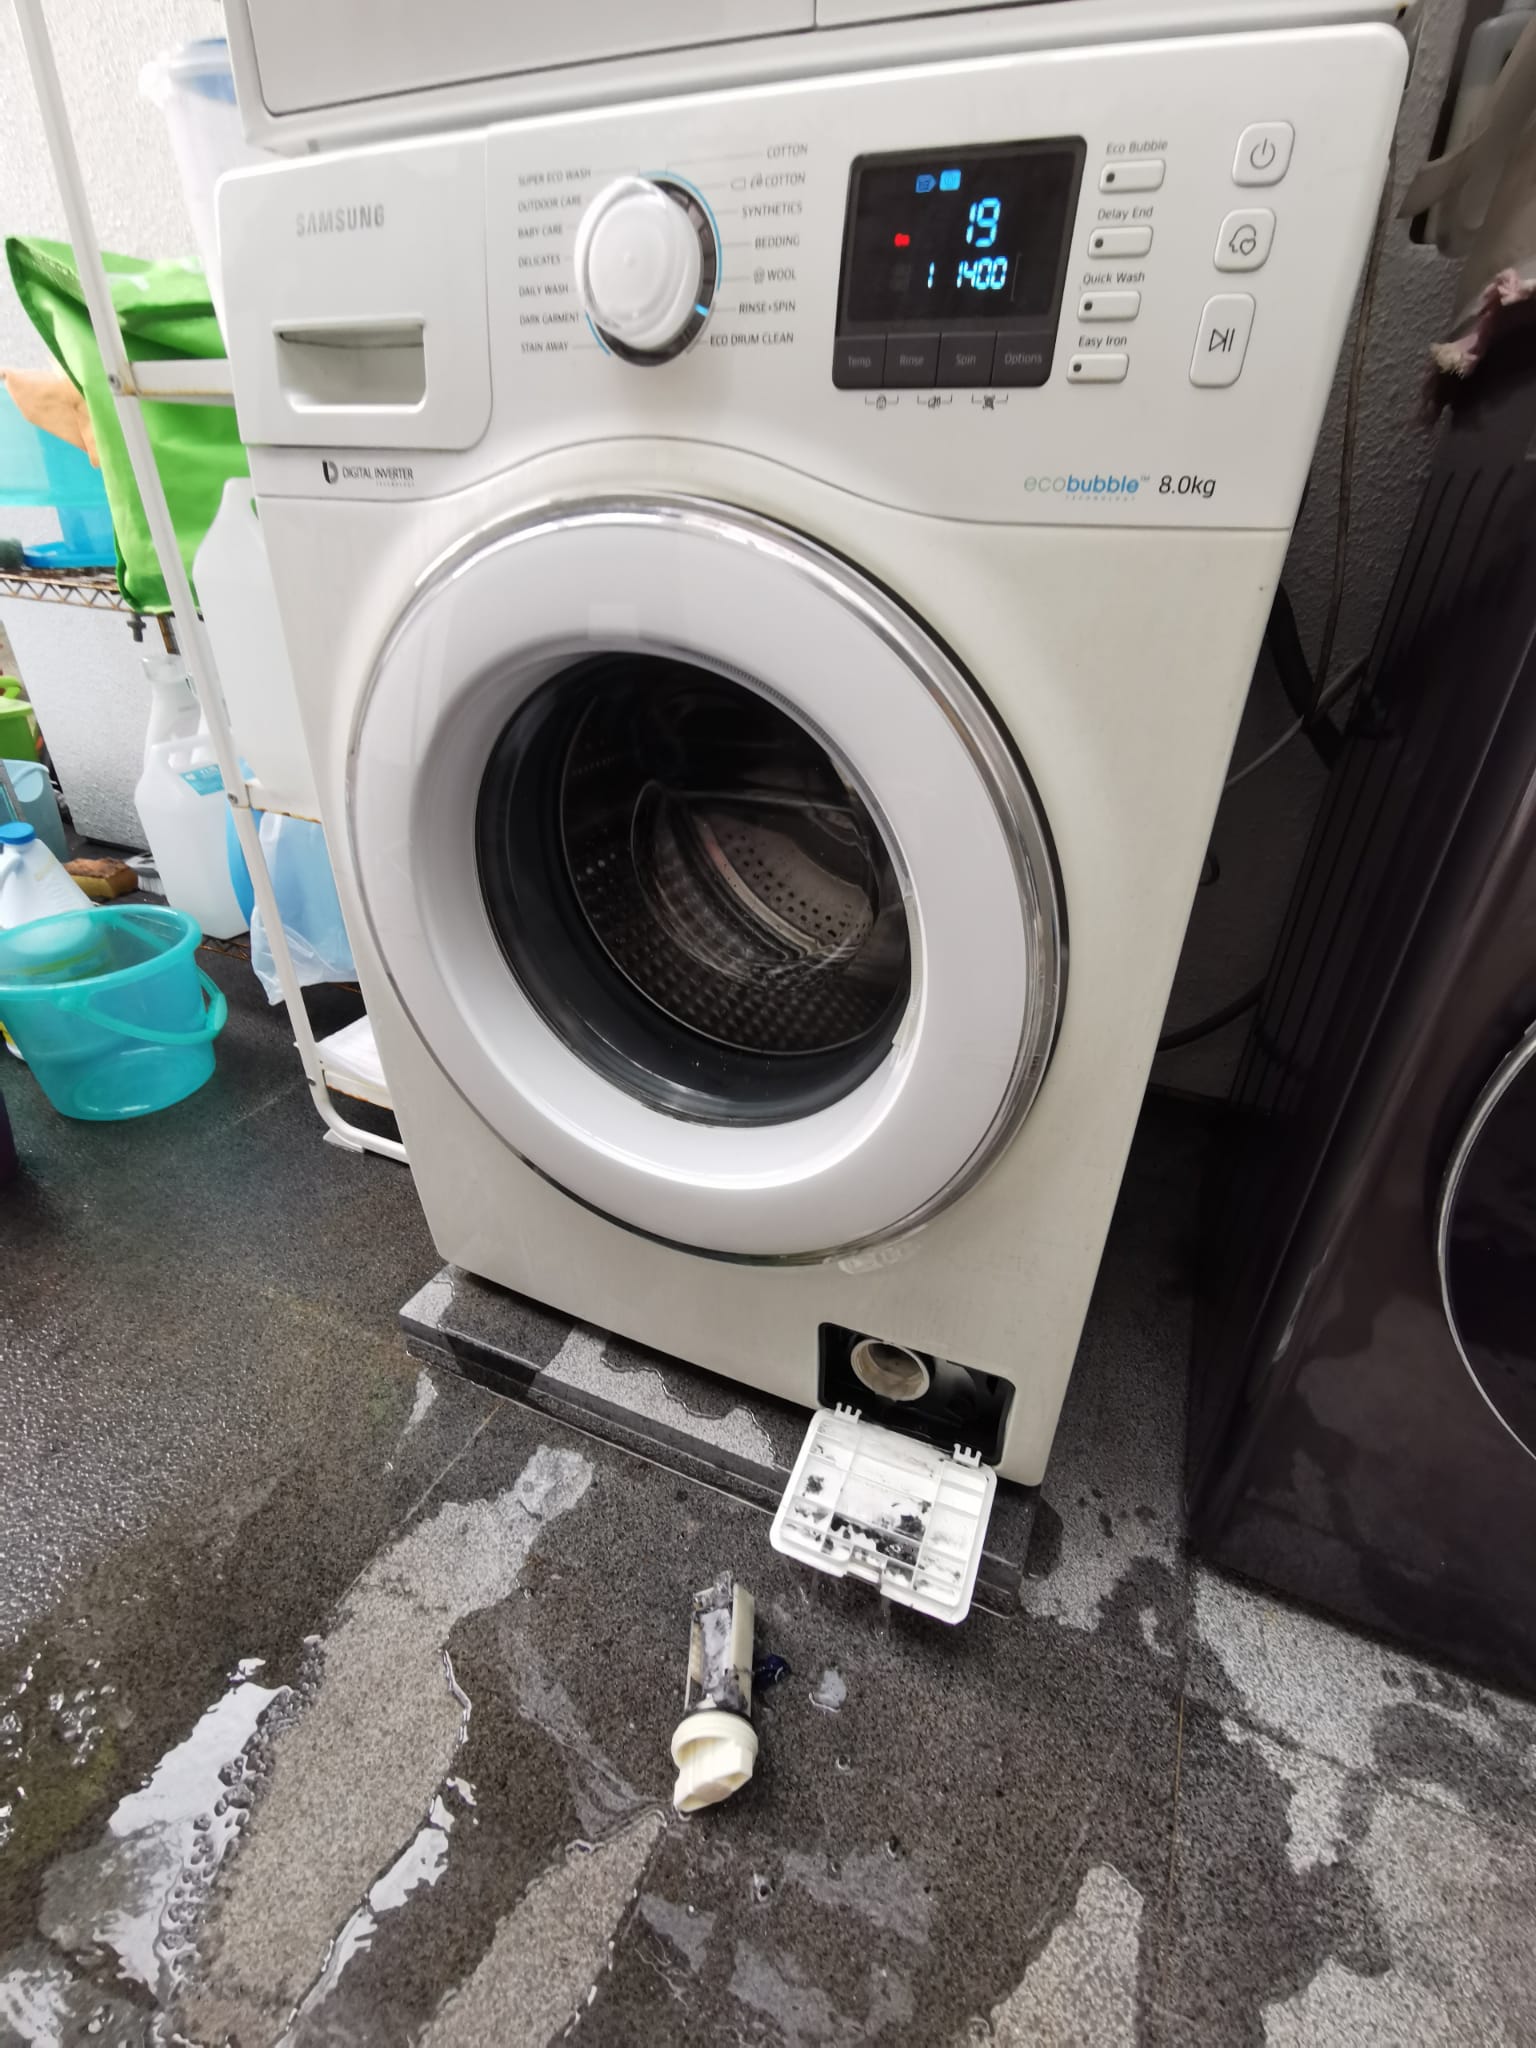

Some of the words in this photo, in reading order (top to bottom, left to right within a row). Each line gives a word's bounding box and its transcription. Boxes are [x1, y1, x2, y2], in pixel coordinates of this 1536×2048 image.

[766, 144, 809, 159] COTTON
[1106, 142, 1126, 155] Eco
[1129, 139, 1168, 153] Bubble
[546, 170, 564, 184] ECO
[565, 168, 592, 181] WASH
[765, 171, 806, 188] COTTON
[561, 194, 582, 208] CARE
[742, 200, 803, 217] SYNTHETICS
[295, 203, 386, 238] SAMSUNG
[1097, 207, 1129, 221] Delay
[1132, 205, 1154, 219] End
[518, 226, 539, 239] BABY
[542, 222, 563, 237] CARE
[965, 197, 1001, 248] 19
[754, 235, 801, 250] BEDDING
[518, 254, 561, 268] DELICATES
[767, 268, 797, 282] WOOL
[956, 255, 1008, 291] 1400
[1083, 271, 1113, 286] Quick
[1116, 270, 1146, 284] Wash
[518, 284, 542, 298] DAILY
[544, 282, 569, 296] WASH
[519, 313, 541, 327] DARK
[542, 311, 580, 325] GARMENT
[520, 341, 544, 354] STAIN
[545, 340, 569, 353] AWAY
[709, 334, 729, 347] ECO
[730, 333, 760, 346] DRUM
[762, 331, 795, 345] CLEAN
[1078, 334, 1103, 348] Easy
[1106, 335, 1128, 347] Iron
[848, 355, 872, 368] Temp
[899, 354, 925, 367] Rinse
[955, 352, 977, 367] Spin
[1004, 351, 1043, 366] Options
[342, 466, 373, 480] DIGITAL
[374, 466, 415, 482] INVERTER
[1158, 474, 1216, 499] 8.0kg
